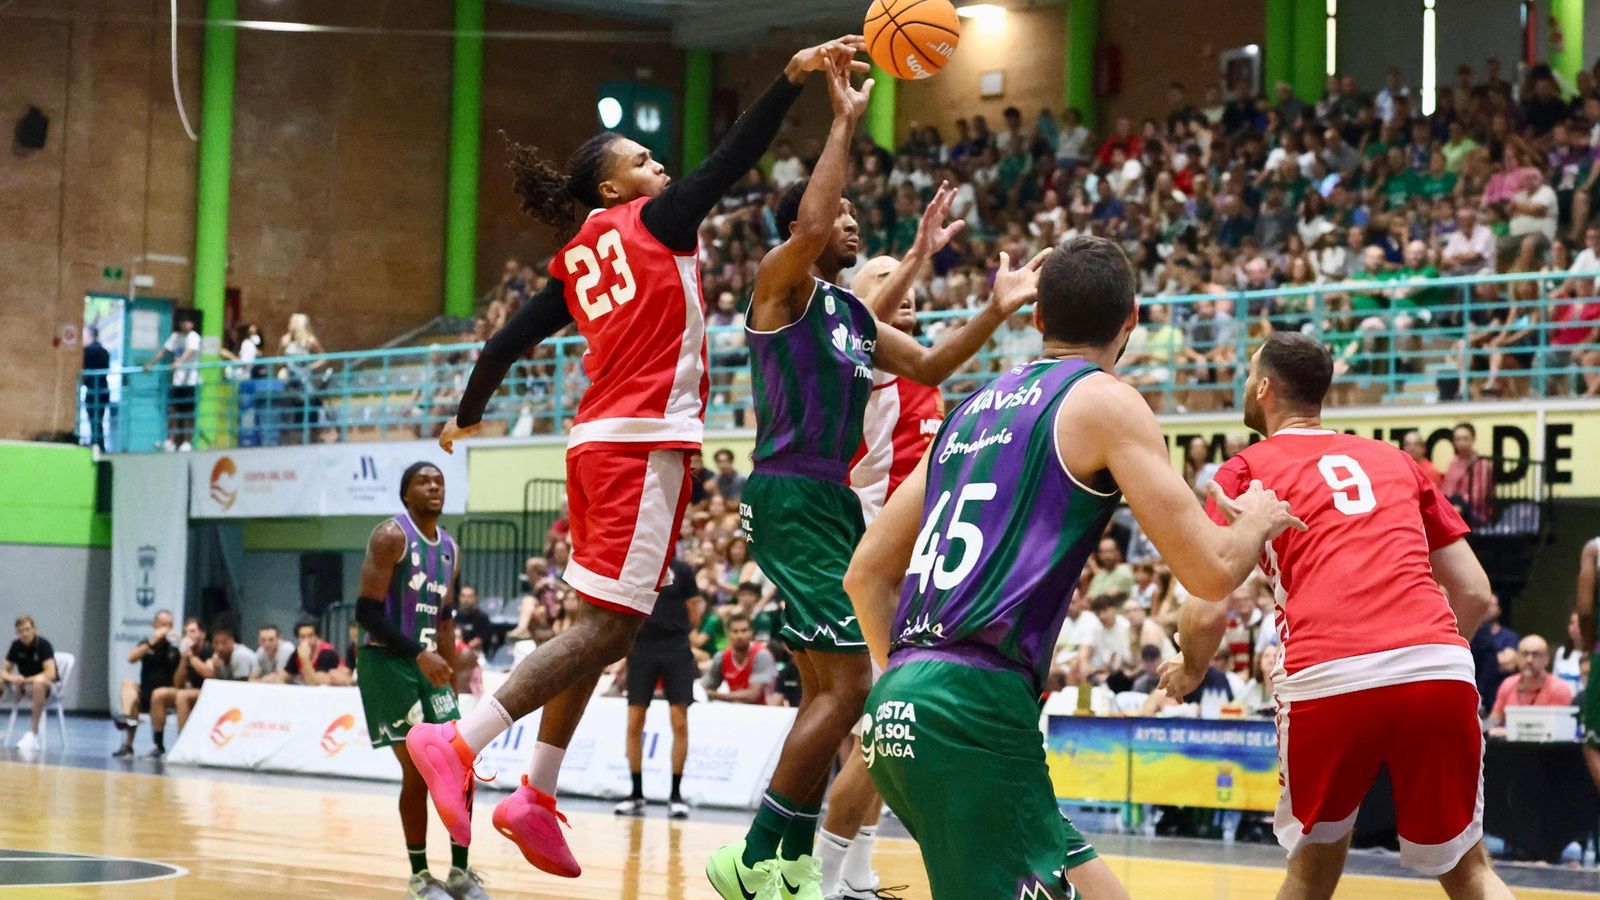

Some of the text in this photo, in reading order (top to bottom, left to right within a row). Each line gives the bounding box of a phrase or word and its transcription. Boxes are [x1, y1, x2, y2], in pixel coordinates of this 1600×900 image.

[564, 228, 636, 322] 23
[1492, 423, 1574, 484] DE
[1317, 454, 1377, 516] 9
[905, 482, 997, 594] 45
[419, 627, 437, 652] 5
[885, 723, 916, 741] SOL
